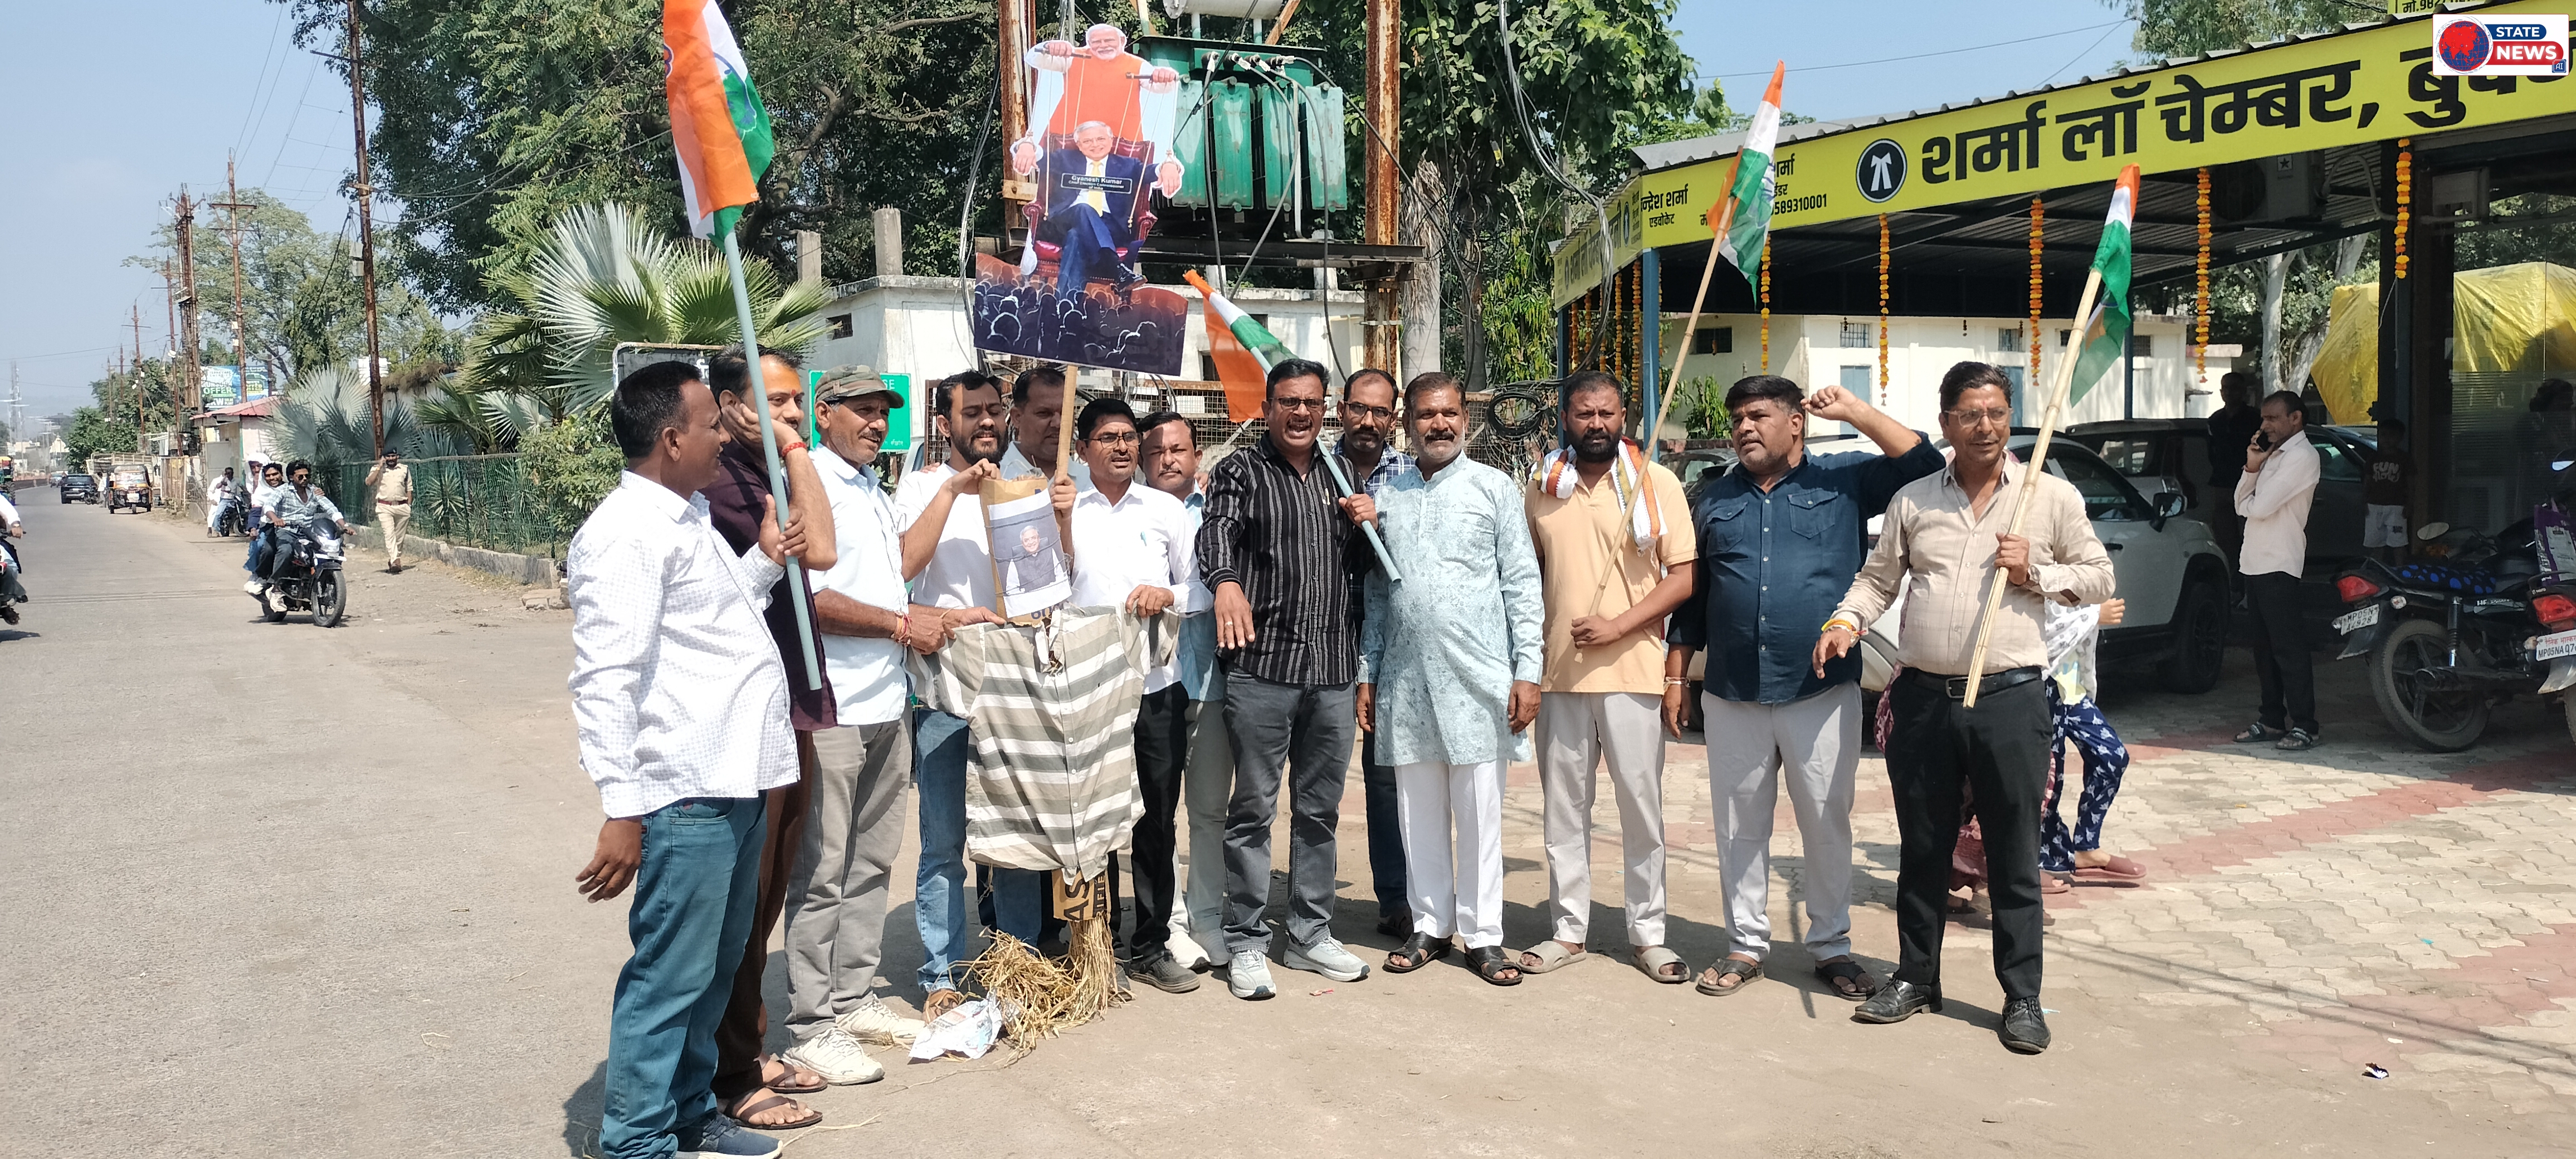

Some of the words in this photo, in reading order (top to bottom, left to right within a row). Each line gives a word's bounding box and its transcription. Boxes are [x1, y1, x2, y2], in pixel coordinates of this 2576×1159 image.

[1922, 100, 2047, 184] शर्मा
[2055, 80, 2151, 162] लॉ
[2155, 59, 2379, 144] चेम्बर,
[1071, 174, 1100, 183] Gyanesh
[1666, 183, 1689, 207] शर्मा
[1770, 193, 1827, 216] 589310001
[1649, 211, 1675, 228] एडवोकेट
